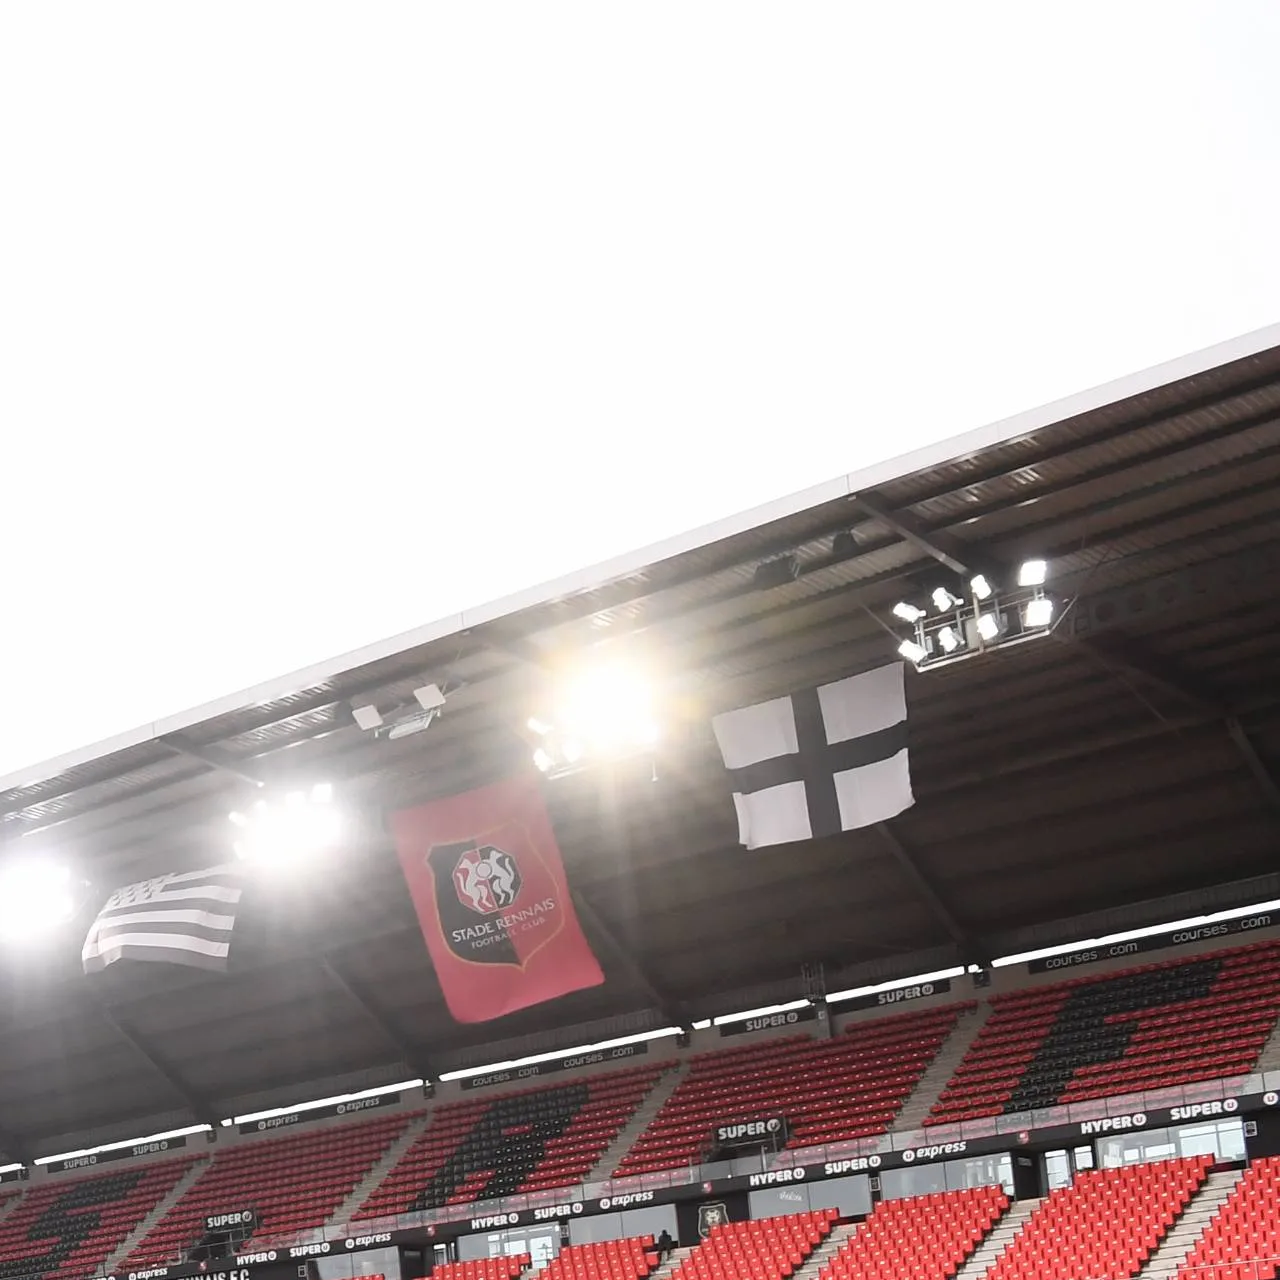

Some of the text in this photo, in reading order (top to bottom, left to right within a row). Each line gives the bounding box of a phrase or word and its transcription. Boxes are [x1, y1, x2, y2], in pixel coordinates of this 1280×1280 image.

[452, 898, 555, 942] STADE RENNAIS
[1172, 924, 1228, 944] courses
[1045, 950, 1097, 969] courses
[878, 987, 921, 1004] SUPER
[746, 1017, 786, 1031] SUPER
[563, 1052, 603, 1068] courses
[472, 1072, 510, 1087] courses
[346, 1097, 380, 1111] express
[1081, 1117, 1132, 1134] HYPER
[1170, 1102, 1223, 1120] SUPER
[718, 1121, 766, 1140] SUPER
[133, 1143, 160, 1155] SUPER
[63, 1157, 90, 1169] SUPER
[749, 1171, 792, 1187] HYPER
[825, 1161, 868, 1175] SUPER
[916, 1141, 966, 1159] express
[471, 1217, 508, 1230] HYPER
[534, 1205, 571, 1219] SUPER
[612, 1191, 654, 1207] express
[207, 1213, 241, 1228] SUPER
[237, 1233, 391, 1265] HYPER SUPER express
[137, 1267, 167, 1280] express
